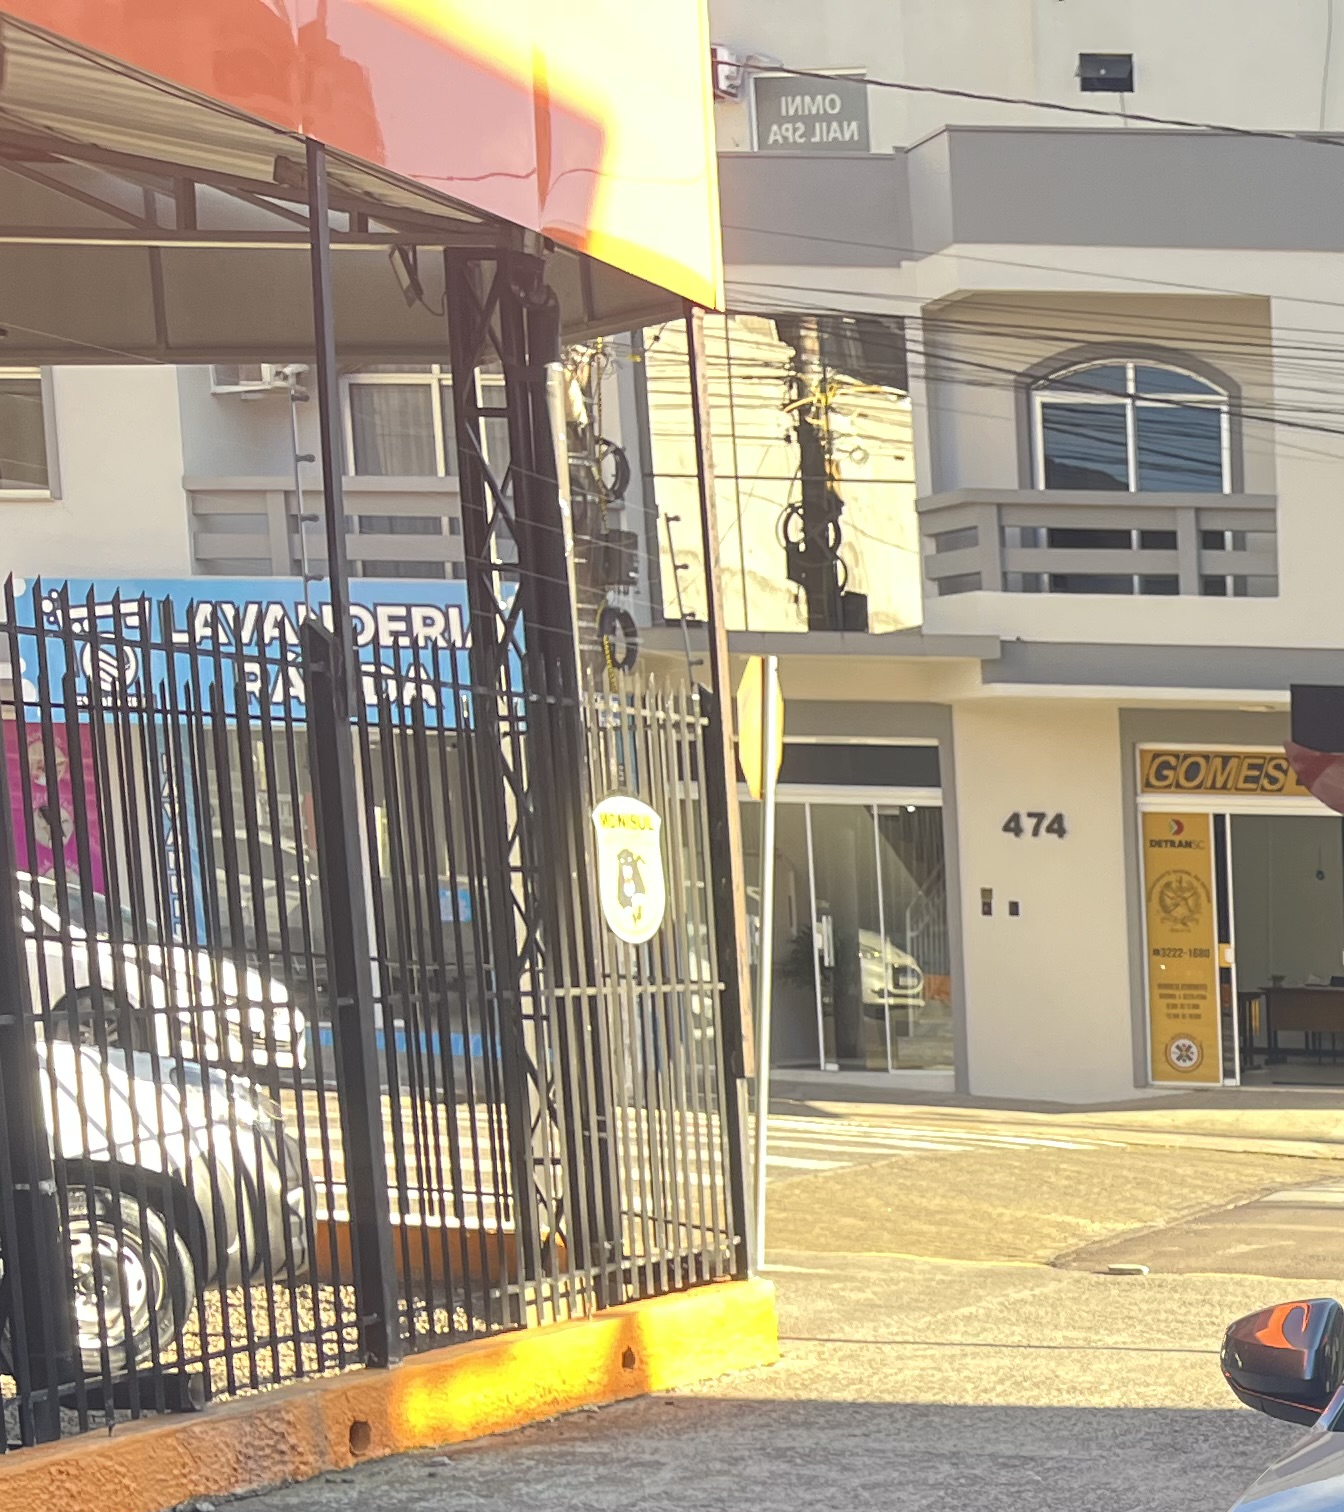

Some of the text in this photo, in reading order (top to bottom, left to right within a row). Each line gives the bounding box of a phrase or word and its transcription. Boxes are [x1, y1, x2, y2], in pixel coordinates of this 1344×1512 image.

[158, 600, 472, 649] LAVANDERI
[1148, 754, 1290, 791] GOMES
[1002, 812, 1067, 838] 474
